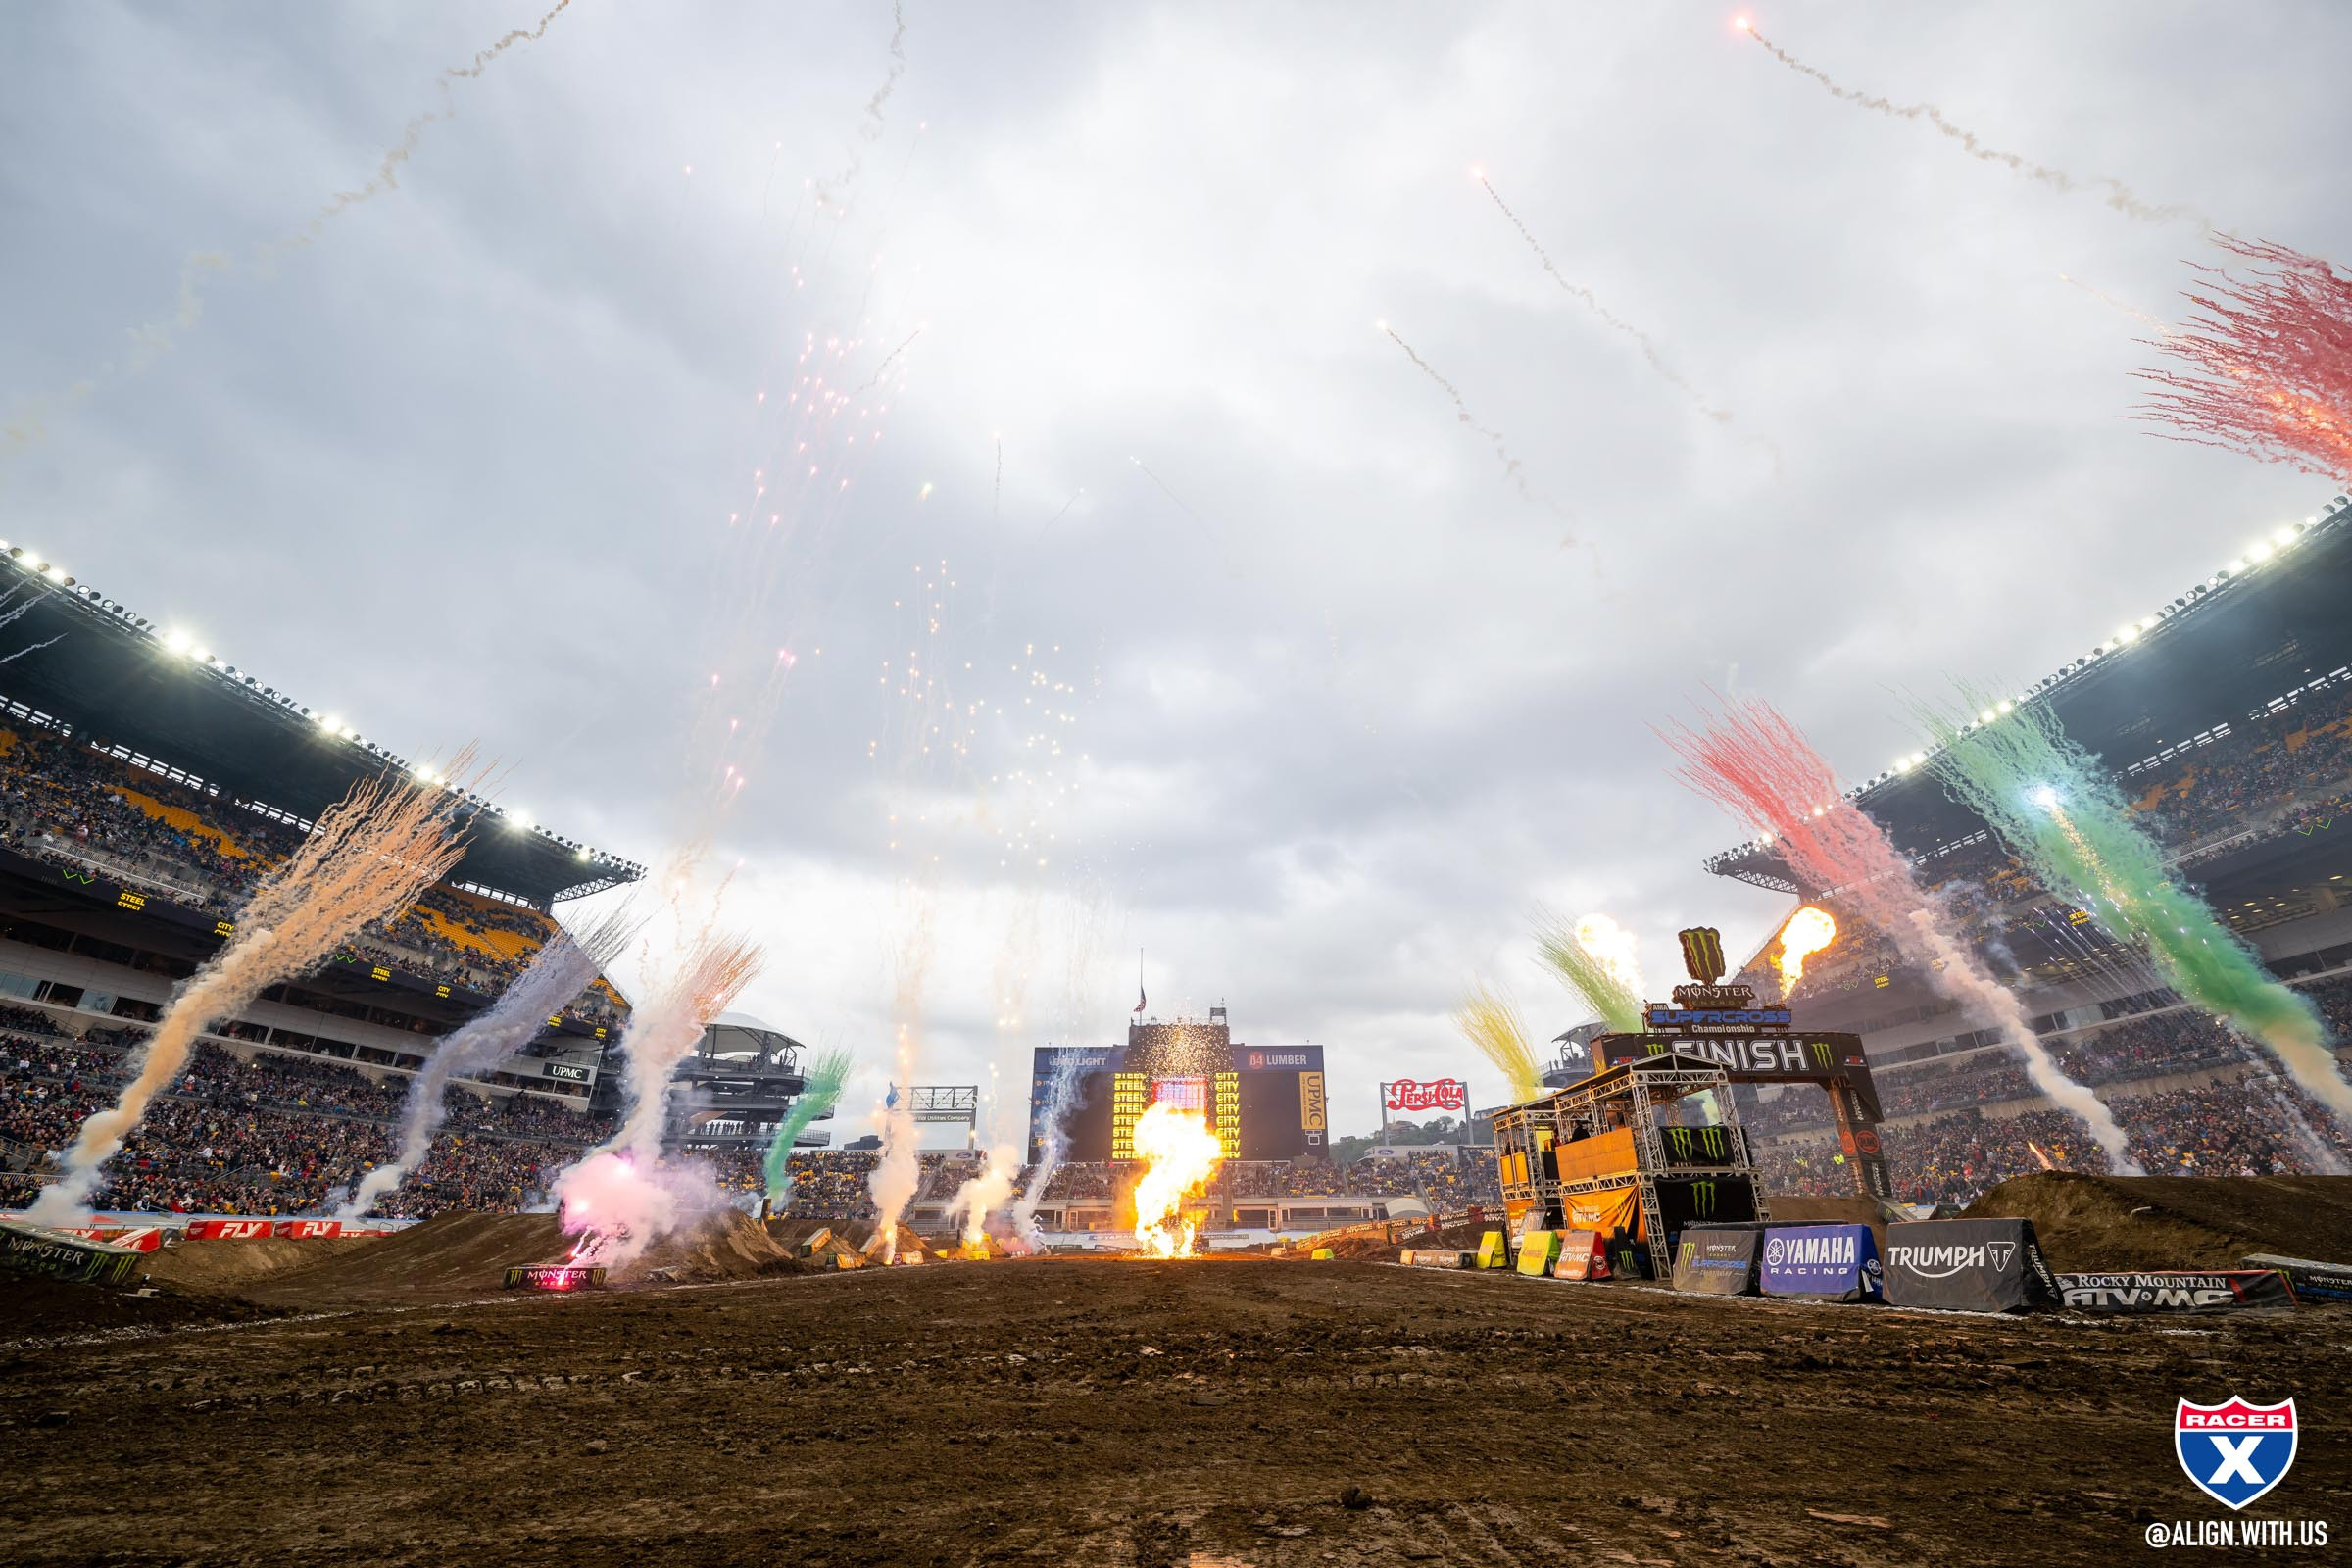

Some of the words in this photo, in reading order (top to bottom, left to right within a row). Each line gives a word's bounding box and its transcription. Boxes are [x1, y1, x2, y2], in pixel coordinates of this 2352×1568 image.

[121, 893, 145, 906] STEEL
[217, 921, 234, 931] CITY
[373, 967, 390, 977] STEEL
[1679, 986, 1754, 1000] MONSTER
[1691, 1024, 1755, 1033] Championship
[1266, 1054, 1307, 1065] LUMBER
[552, 1065, 583, 1079] UPMC
[1114, 1080, 1145, 1091] STEEL
[1216, 1080, 1240, 1091] CITY
[1113, 1092, 1146, 1102] STEEL
[1216, 1092, 1240, 1102] CITY
[1307, 1075, 1323, 1127] UPMC
[1216, 1103, 1240, 1114] CITY
[1216, 1115, 1240, 1126] CITY
[219, 1222, 264, 1238] FLY
[301, 1221, 334, 1236] FLY
[8, 1236, 85, 1266] MONSTER
[1706, 1243, 1736, 1253] MONSTER
[1786, 1236, 1855, 1264] YAMAHA
[1888, 1246, 1984, 1276] TRIUMPH
[2028, 1243, 2053, 1288] TRIUMPH
[527, 1268, 586, 1280] MONSTER
[2078, 1275, 2129, 1288] ROCKY
[2134, 1274, 2226, 1289] MOUNTAIN
